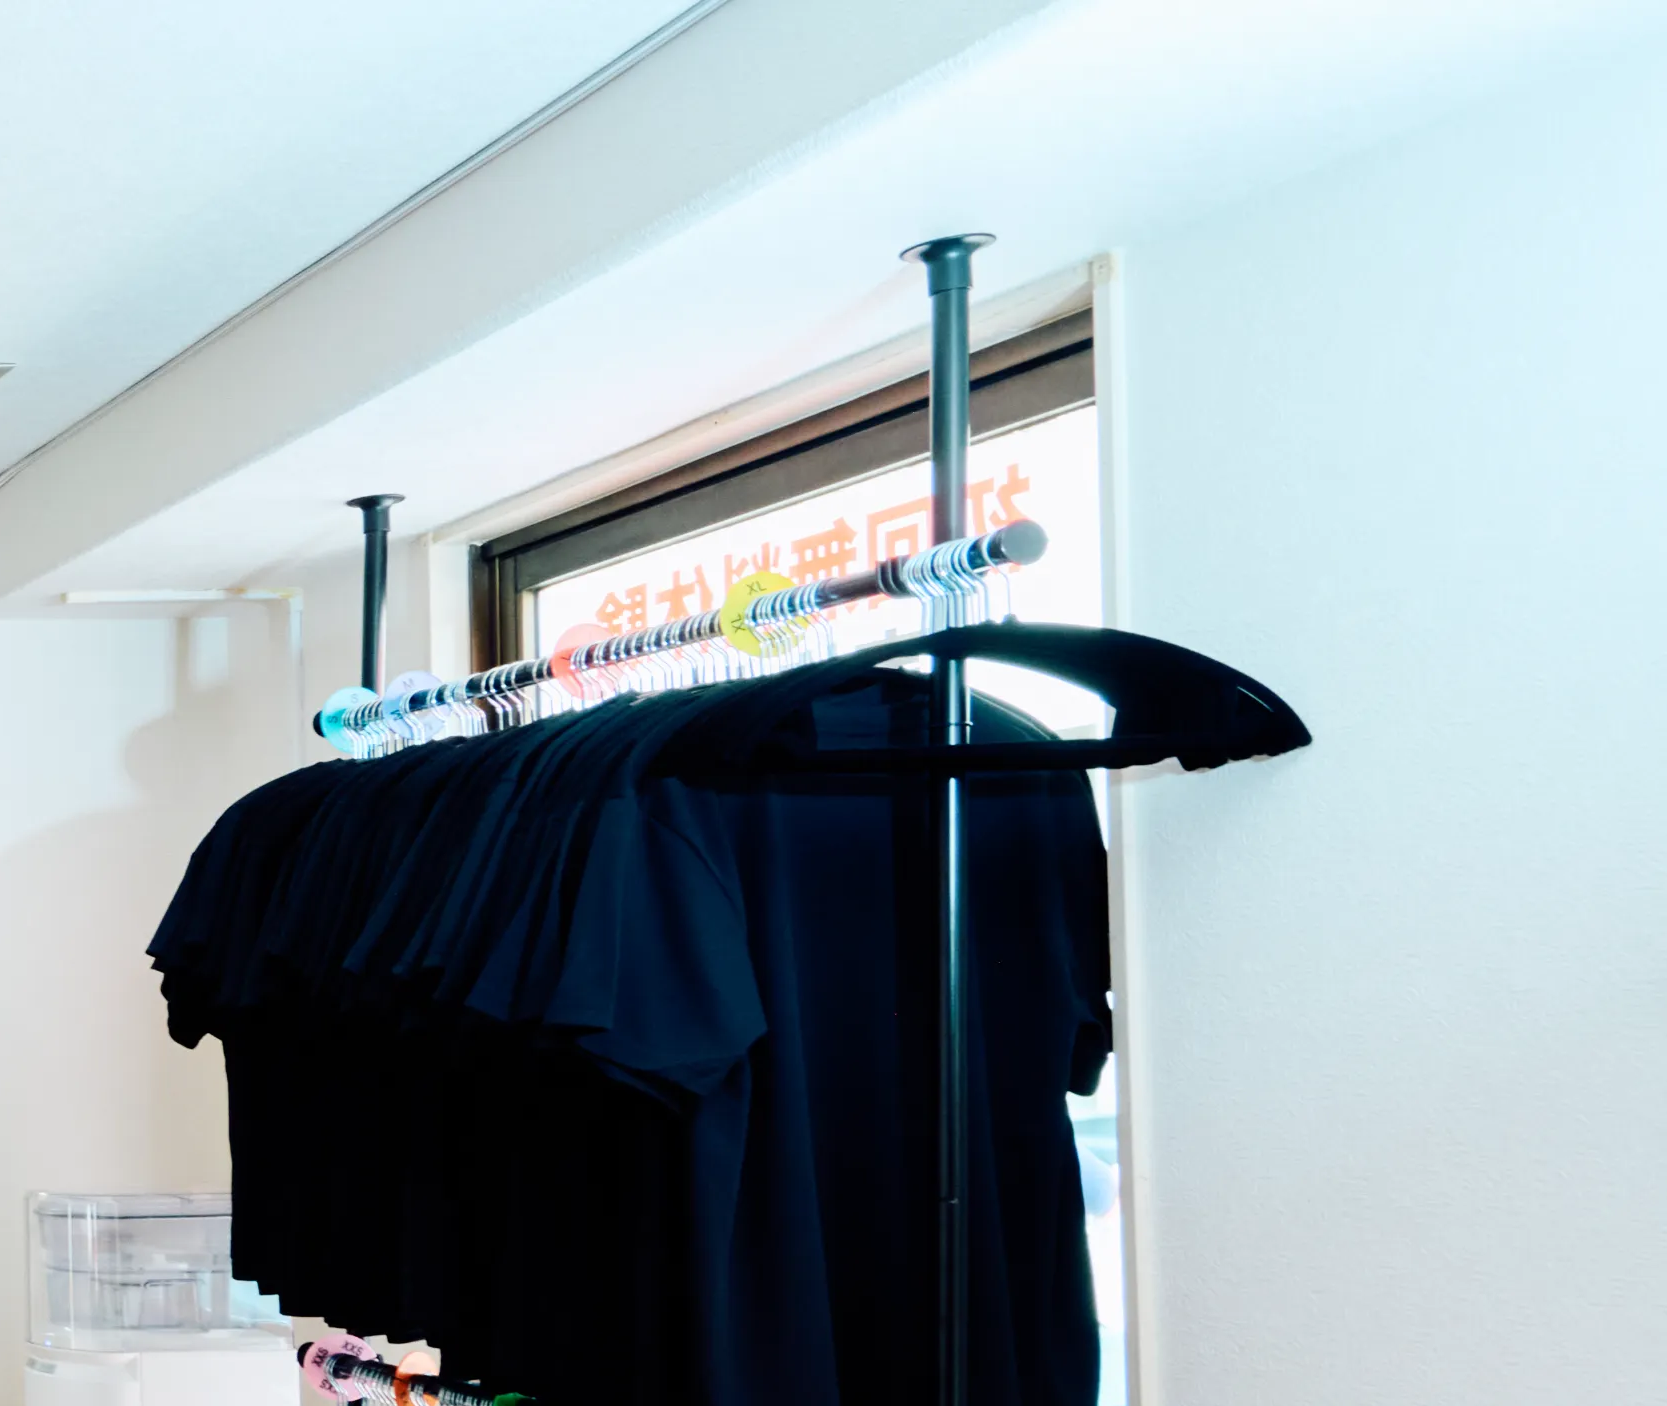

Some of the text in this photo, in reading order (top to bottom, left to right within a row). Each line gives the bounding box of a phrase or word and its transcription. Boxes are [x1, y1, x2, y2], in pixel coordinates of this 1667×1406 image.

[746, 581, 767, 595] XL
[731, 614, 745, 633] XL
[312, 1347, 328, 1367] XXS
[341, 1341, 363, 1356] XXS
